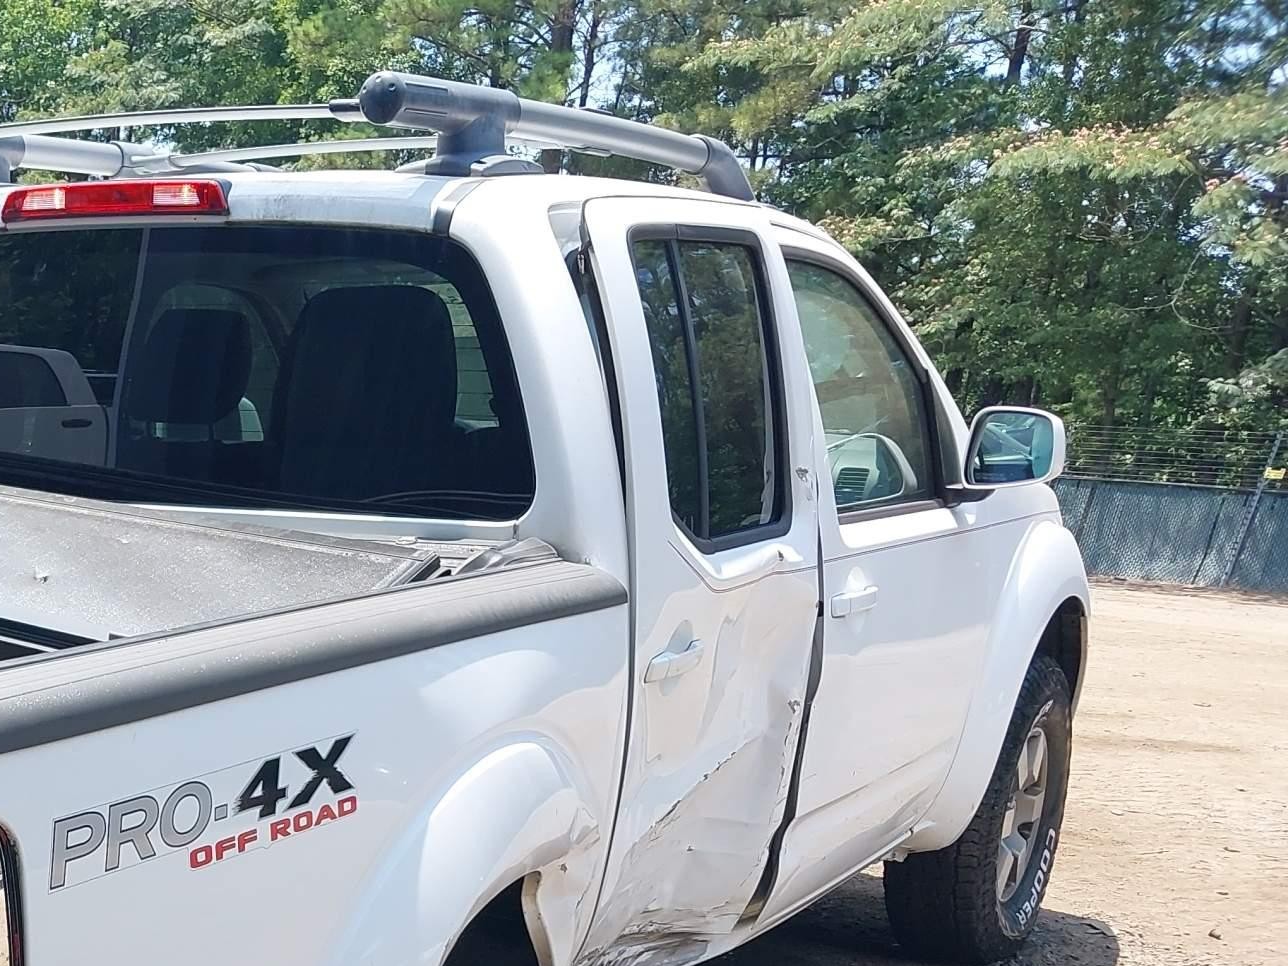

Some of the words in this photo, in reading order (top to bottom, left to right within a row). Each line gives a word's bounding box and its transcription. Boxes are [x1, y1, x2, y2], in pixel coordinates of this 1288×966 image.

[48, 734, 357, 890] PRO-4X
[189, 828, 258, 870] OFF
[269, 795, 358, 842] ROAD
[1015, 828, 1056, 926] COOPER
